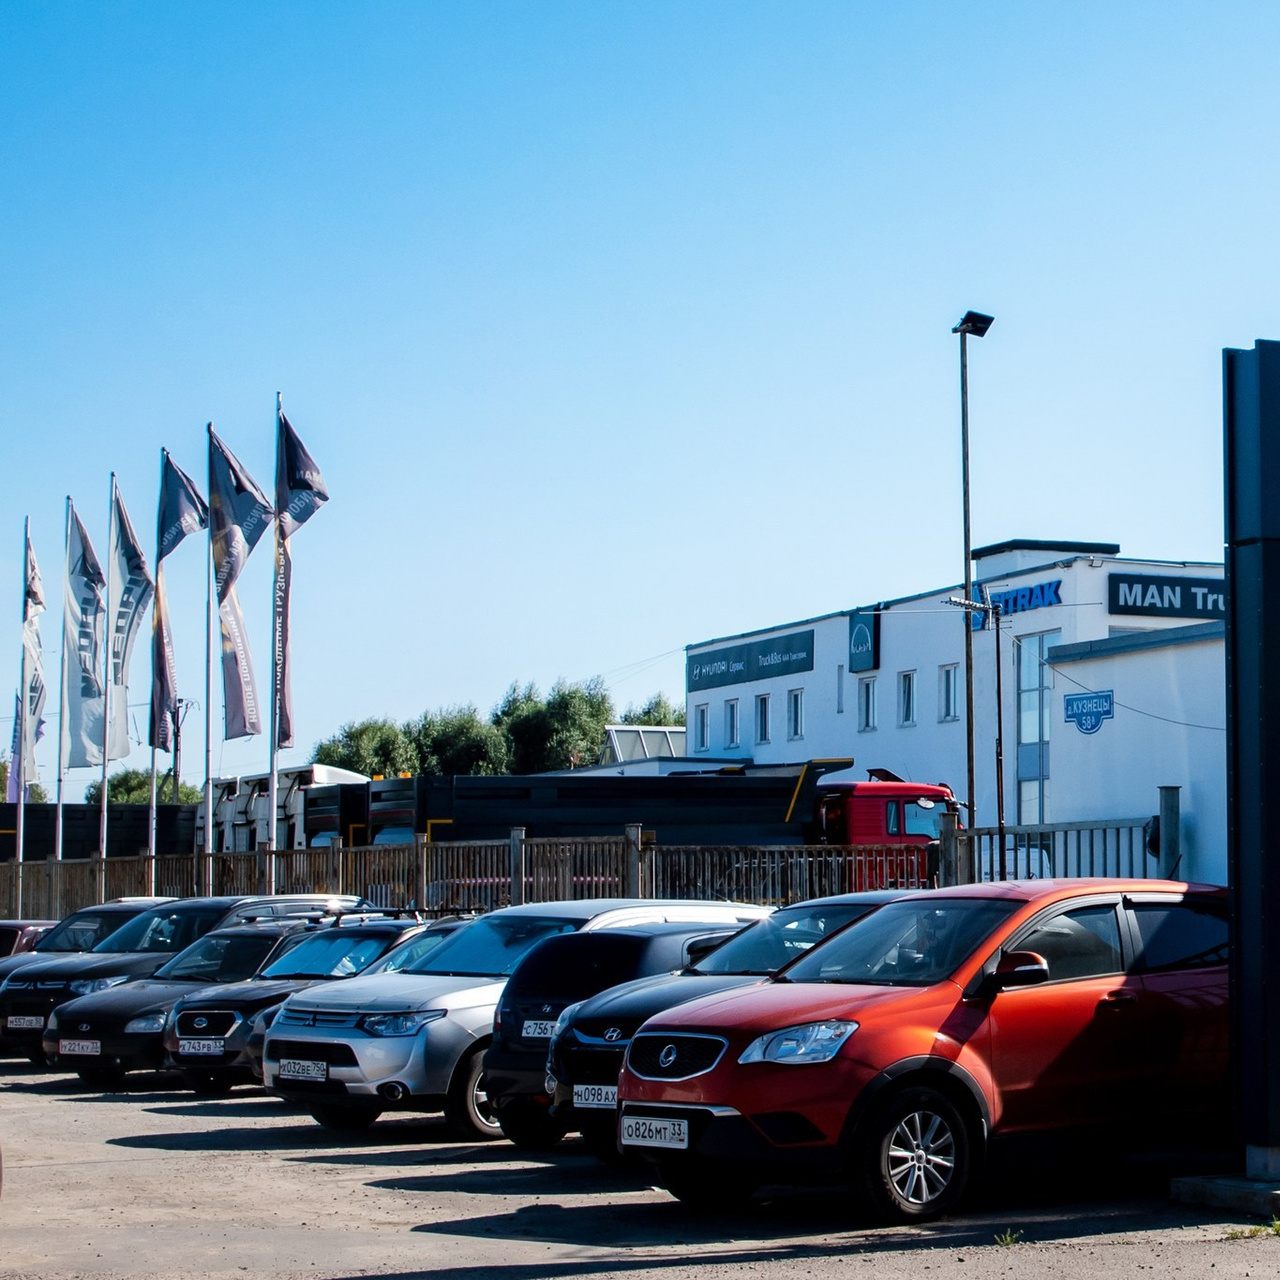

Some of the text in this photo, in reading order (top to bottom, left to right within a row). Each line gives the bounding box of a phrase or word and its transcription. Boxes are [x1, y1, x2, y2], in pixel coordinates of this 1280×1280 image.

[1118, 582, 1181, 609] MAN
[758, 652, 782, 667] Truck&Bus
[701, 662, 728, 677] HYUNDAI
[525, 1022, 556, 1037] С756Т
[181, 1040, 212, 1053] Х743РВ
[281, 1060, 326, 1075] Х032ВЕ 750
[576, 1086, 617, 1103] Н098АХ
[627, 1120, 682, 1141] О826МТ 33
